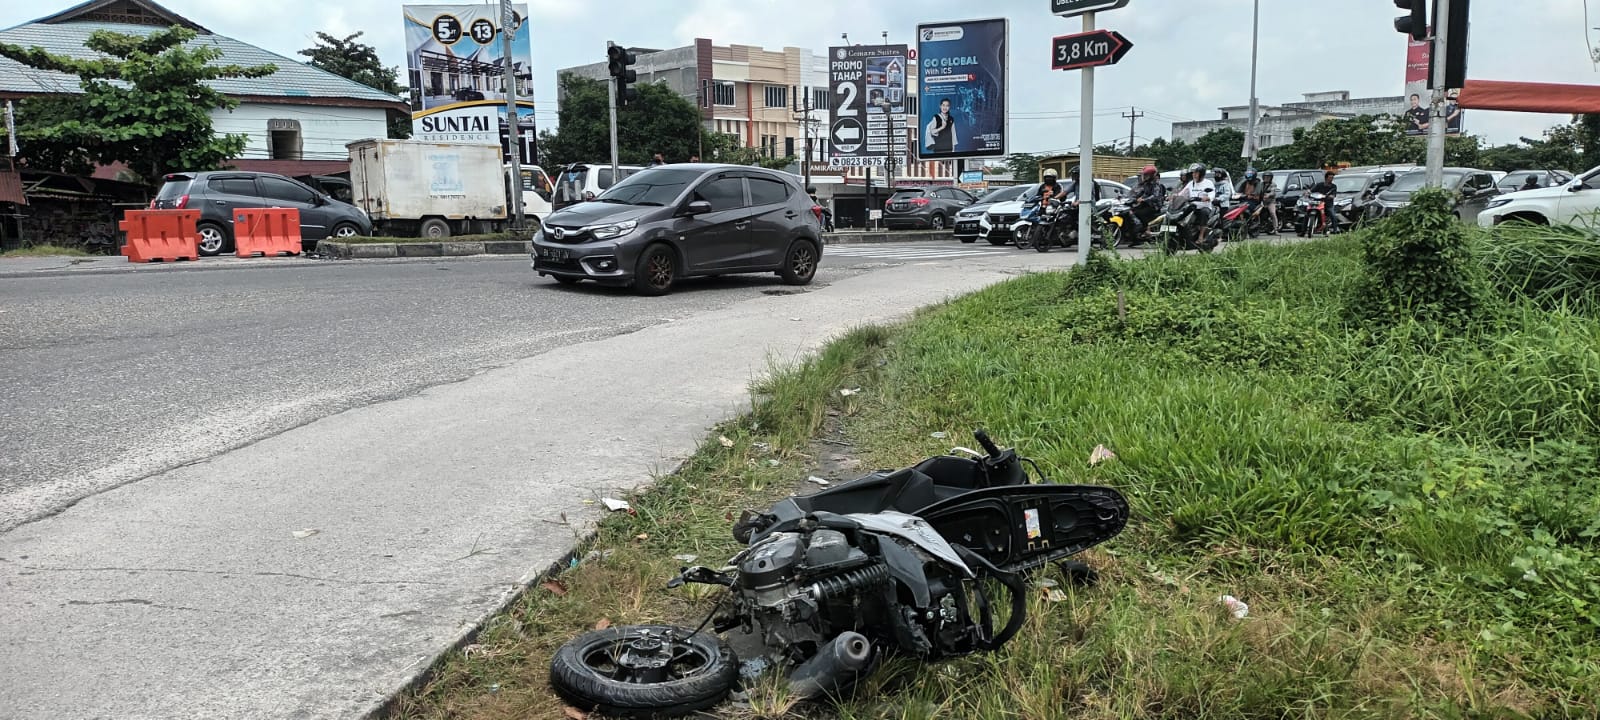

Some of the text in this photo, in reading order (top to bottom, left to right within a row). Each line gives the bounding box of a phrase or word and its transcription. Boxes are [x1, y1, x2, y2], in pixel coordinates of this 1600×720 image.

[438, 22, 451, 39] 5
[474, 25, 492, 39] 13
[1058, 40, 1108, 63] 3,8 Km
[831, 60, 863, 71] PROMO
[923, 56, 978, 68] GO GLOBAL
[832, 71, 863, 81] TAHAP
[836, 81, 859, 117] 2
[422, 115, 490, 132] SUNTAI
[841, 157, 860, 166] 0823
[862, 156, 882, 165] 8675
